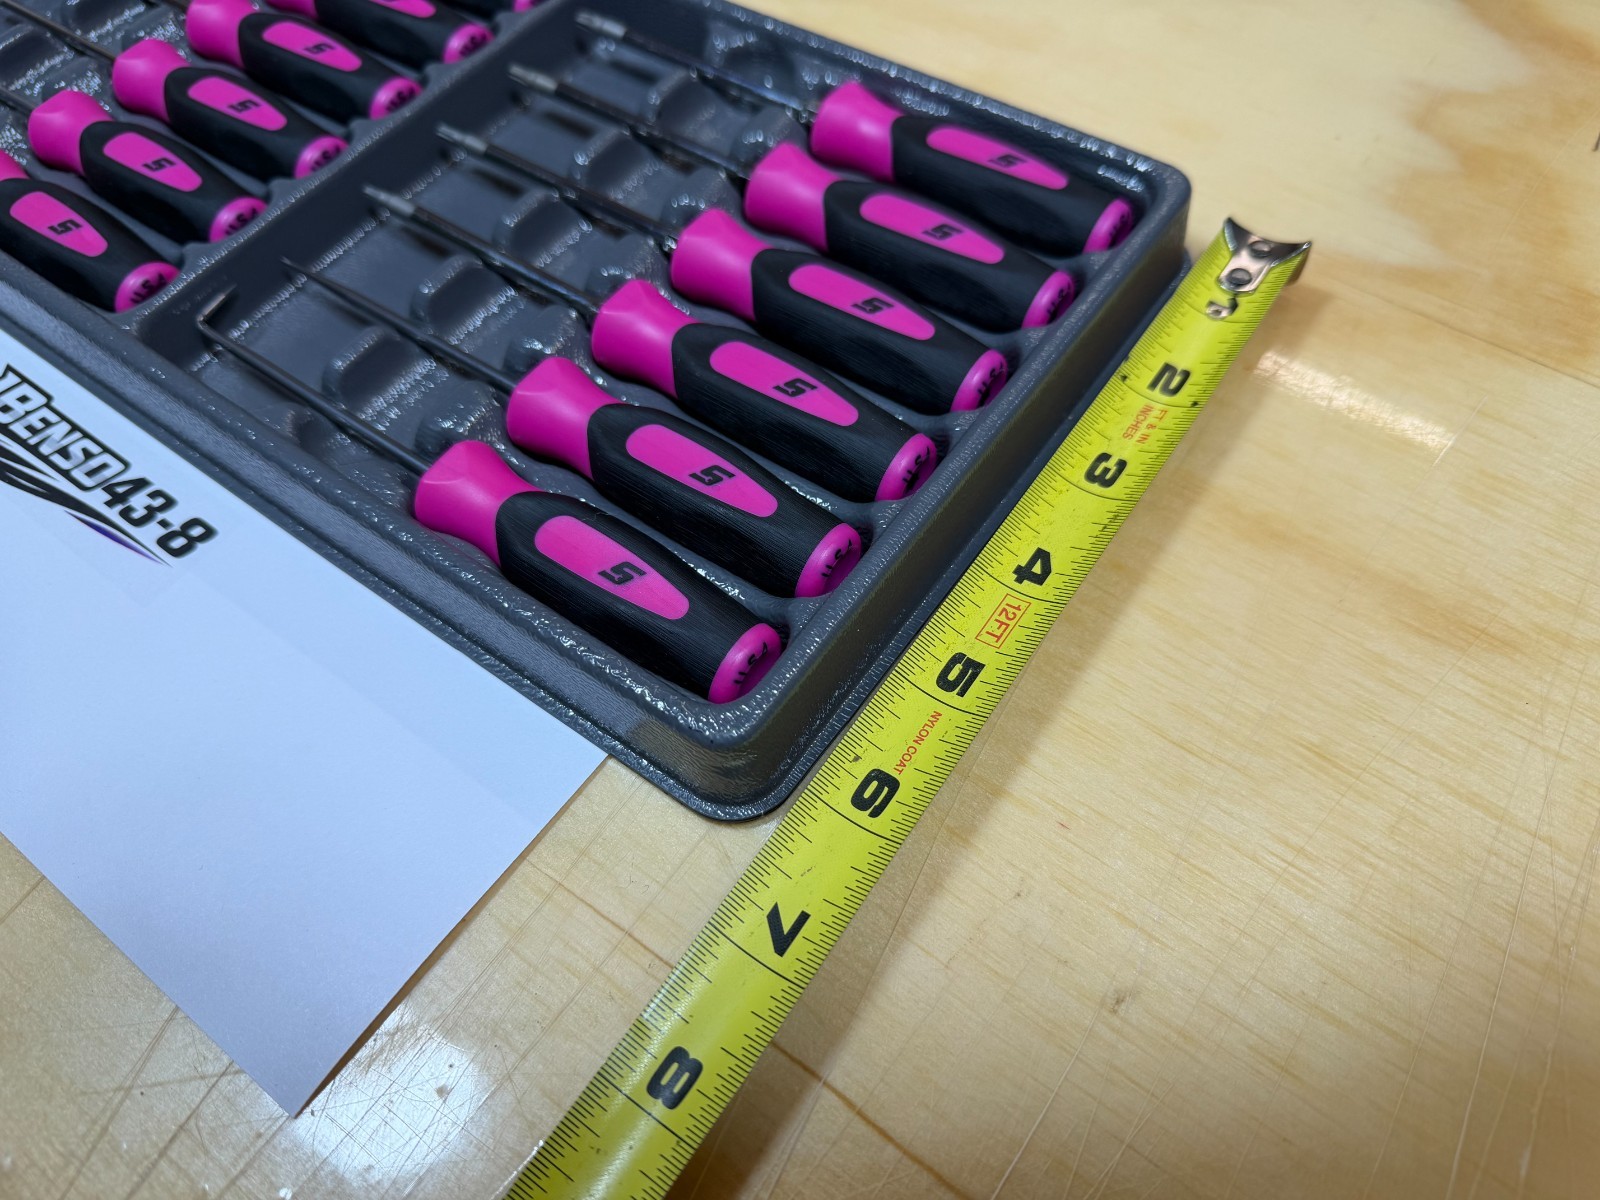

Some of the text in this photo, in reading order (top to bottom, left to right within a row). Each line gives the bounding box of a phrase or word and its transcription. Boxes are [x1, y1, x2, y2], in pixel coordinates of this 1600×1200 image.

[1147, 362, 1190, 397] 2
[1122, 404, 1154, 440] INCHES
[1153, 408, 1168, 421] FT
[1136, 434, 1150, 444] IN
[1084, 451, 1127, 489] 3
[1012, 546, 1052, 586] 4
[984, 601, 1022, 644] 12FT
[936, 652, 986, 697] 5
[893, 710, 943, 776] NYLON COAT
[851, 768, 900, 819] 6
[766, 902, 811, 958] 7
[647, 1046, 704, 1110] 8
